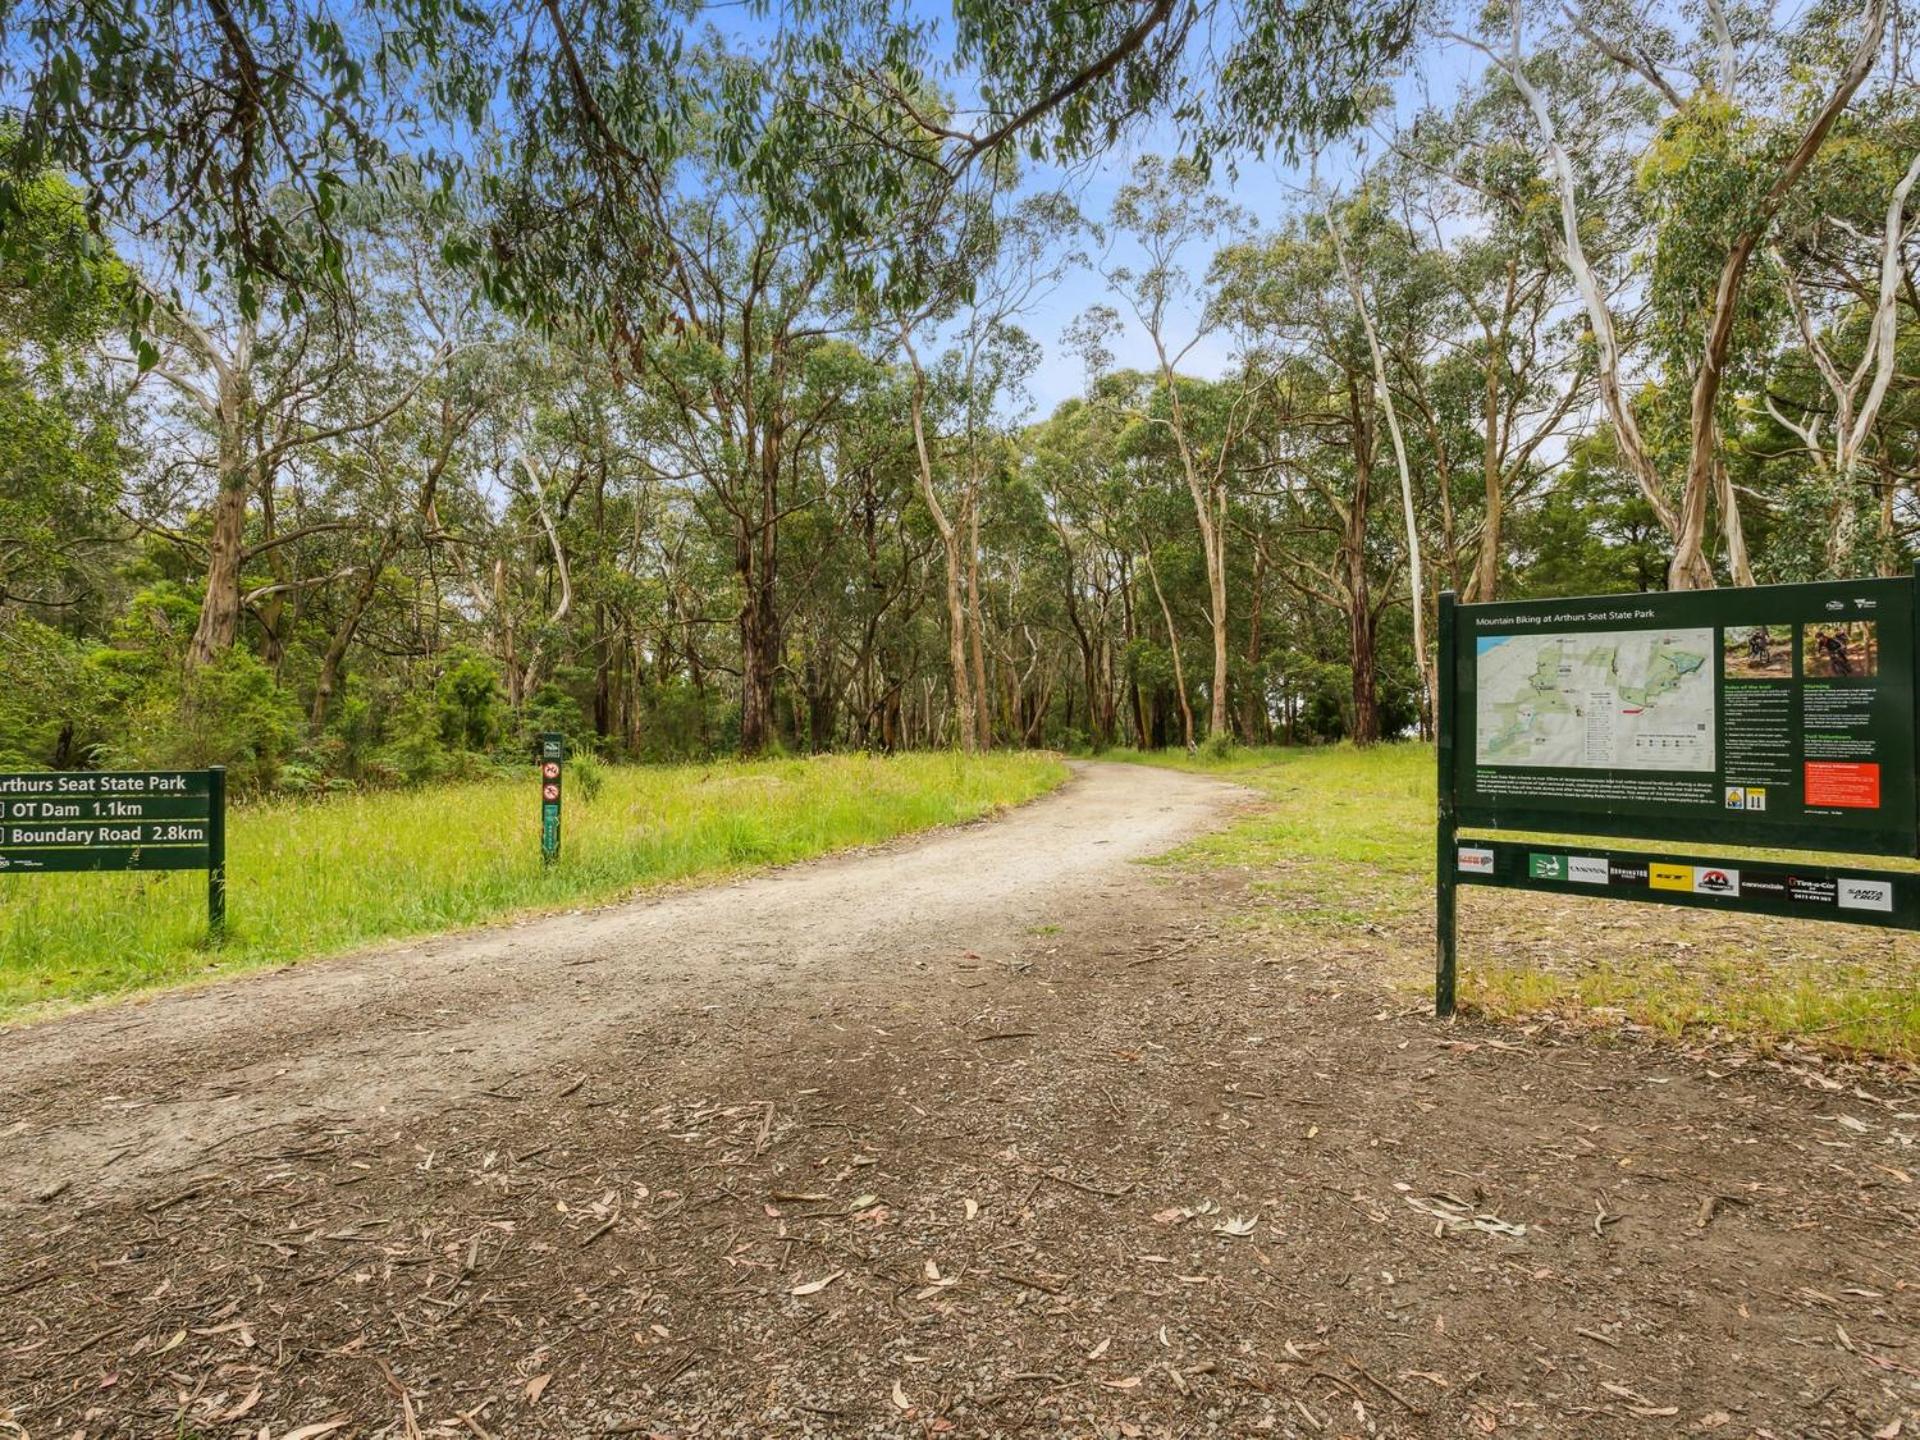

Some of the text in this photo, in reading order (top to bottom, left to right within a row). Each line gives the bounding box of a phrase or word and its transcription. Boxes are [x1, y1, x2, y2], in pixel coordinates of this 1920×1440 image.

[1476, 609, 1655, 626] Mountain Biking at Arthurs Seat State Park
[0, 775, 187, 792] rthurs Seat State Park
[12, 801, 143, 817] OT Dam 1.1km
[12, 825, 204, 845] Boundary Road 2.8km
[1742, 881, 1784, 890] cannondale
[1848, 888, 1883, 896] SANTA
